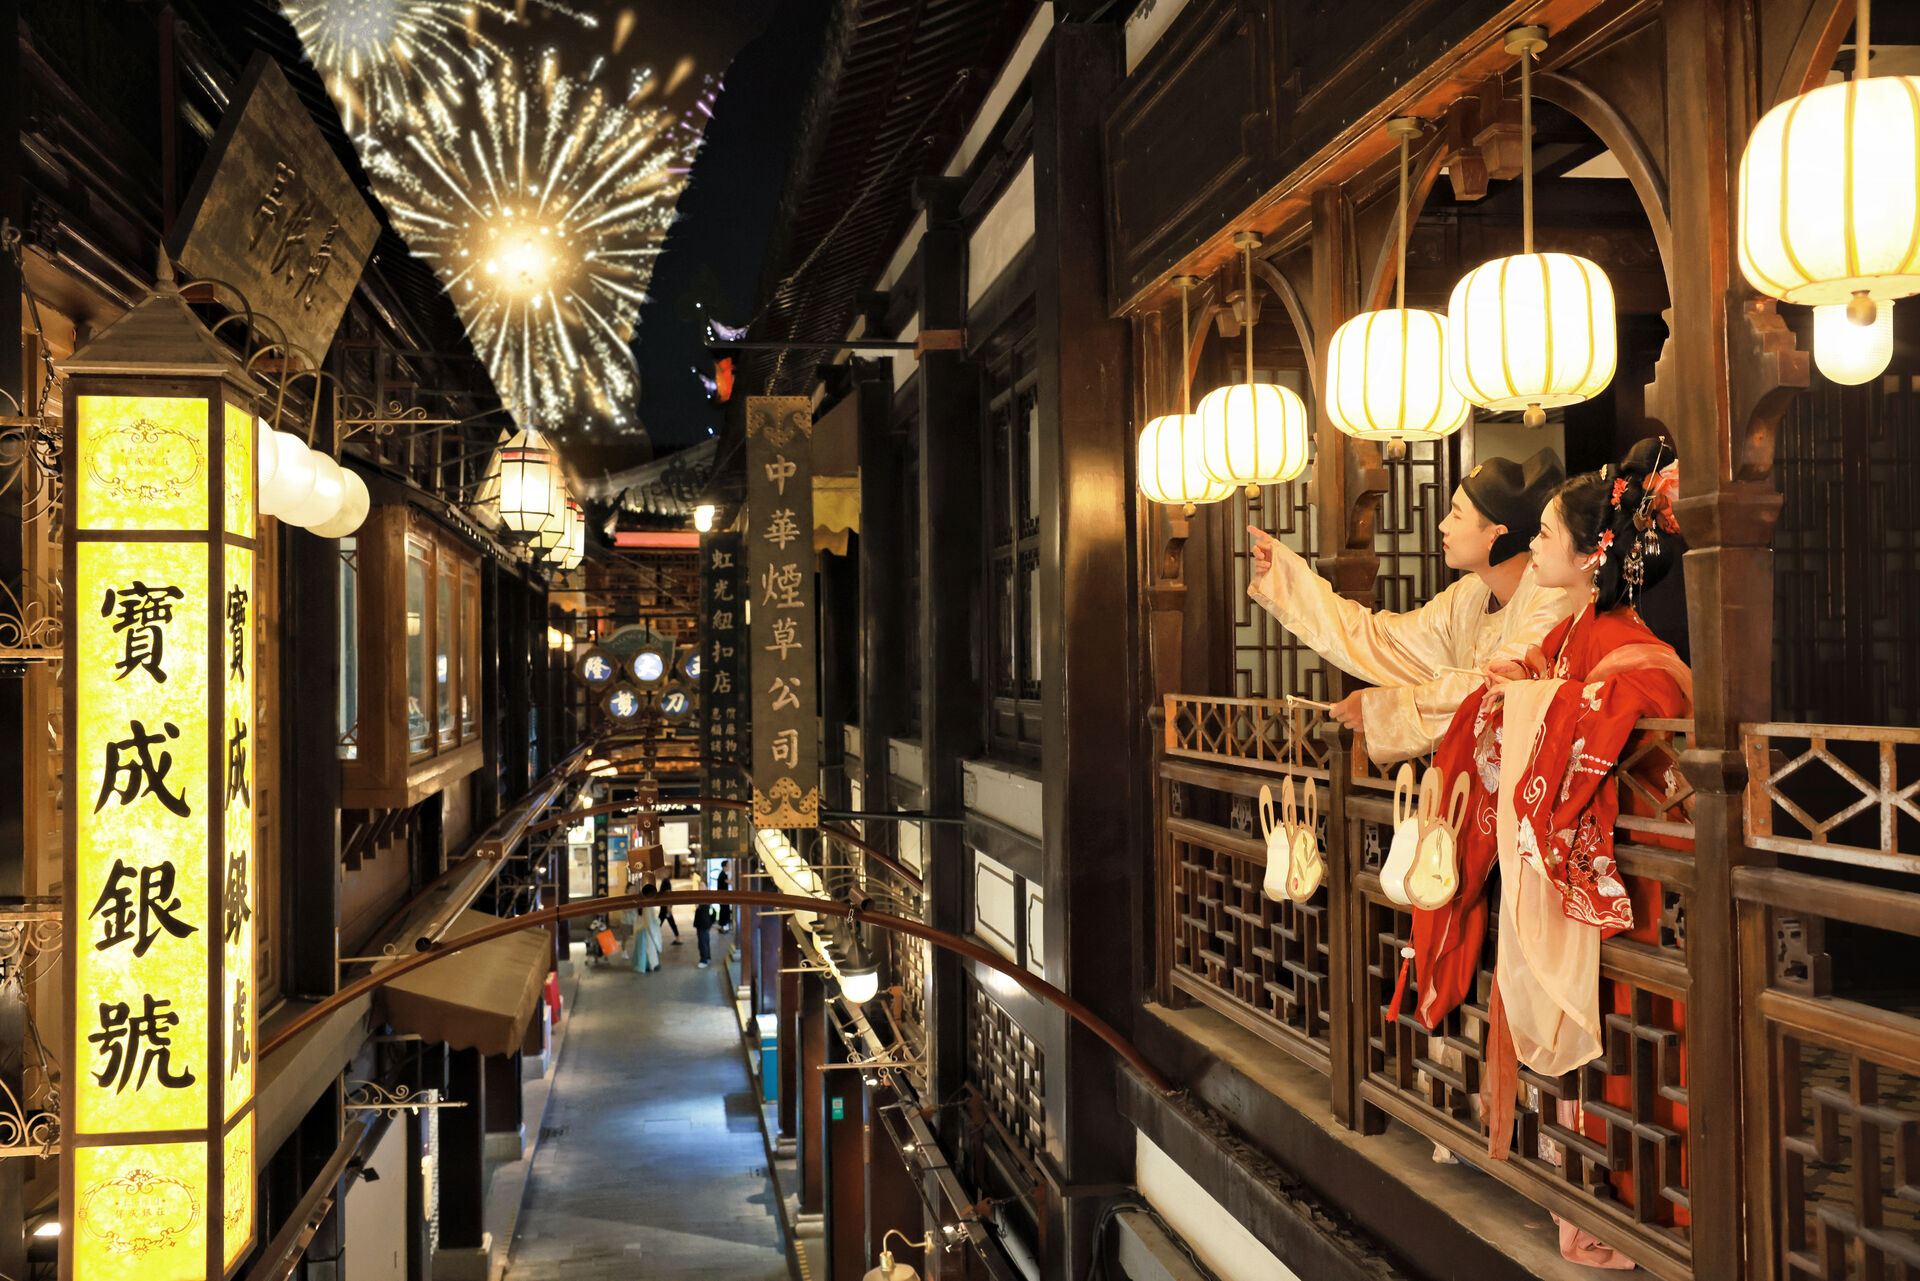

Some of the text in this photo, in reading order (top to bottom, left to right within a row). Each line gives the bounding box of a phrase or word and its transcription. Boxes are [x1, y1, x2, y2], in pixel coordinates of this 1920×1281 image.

[711, 548, 735, 695] 虹光紐扣店
[762, 453, 805, 770] 中華煙草公司
[88, 580, 199, 1095] 寶成銀號
